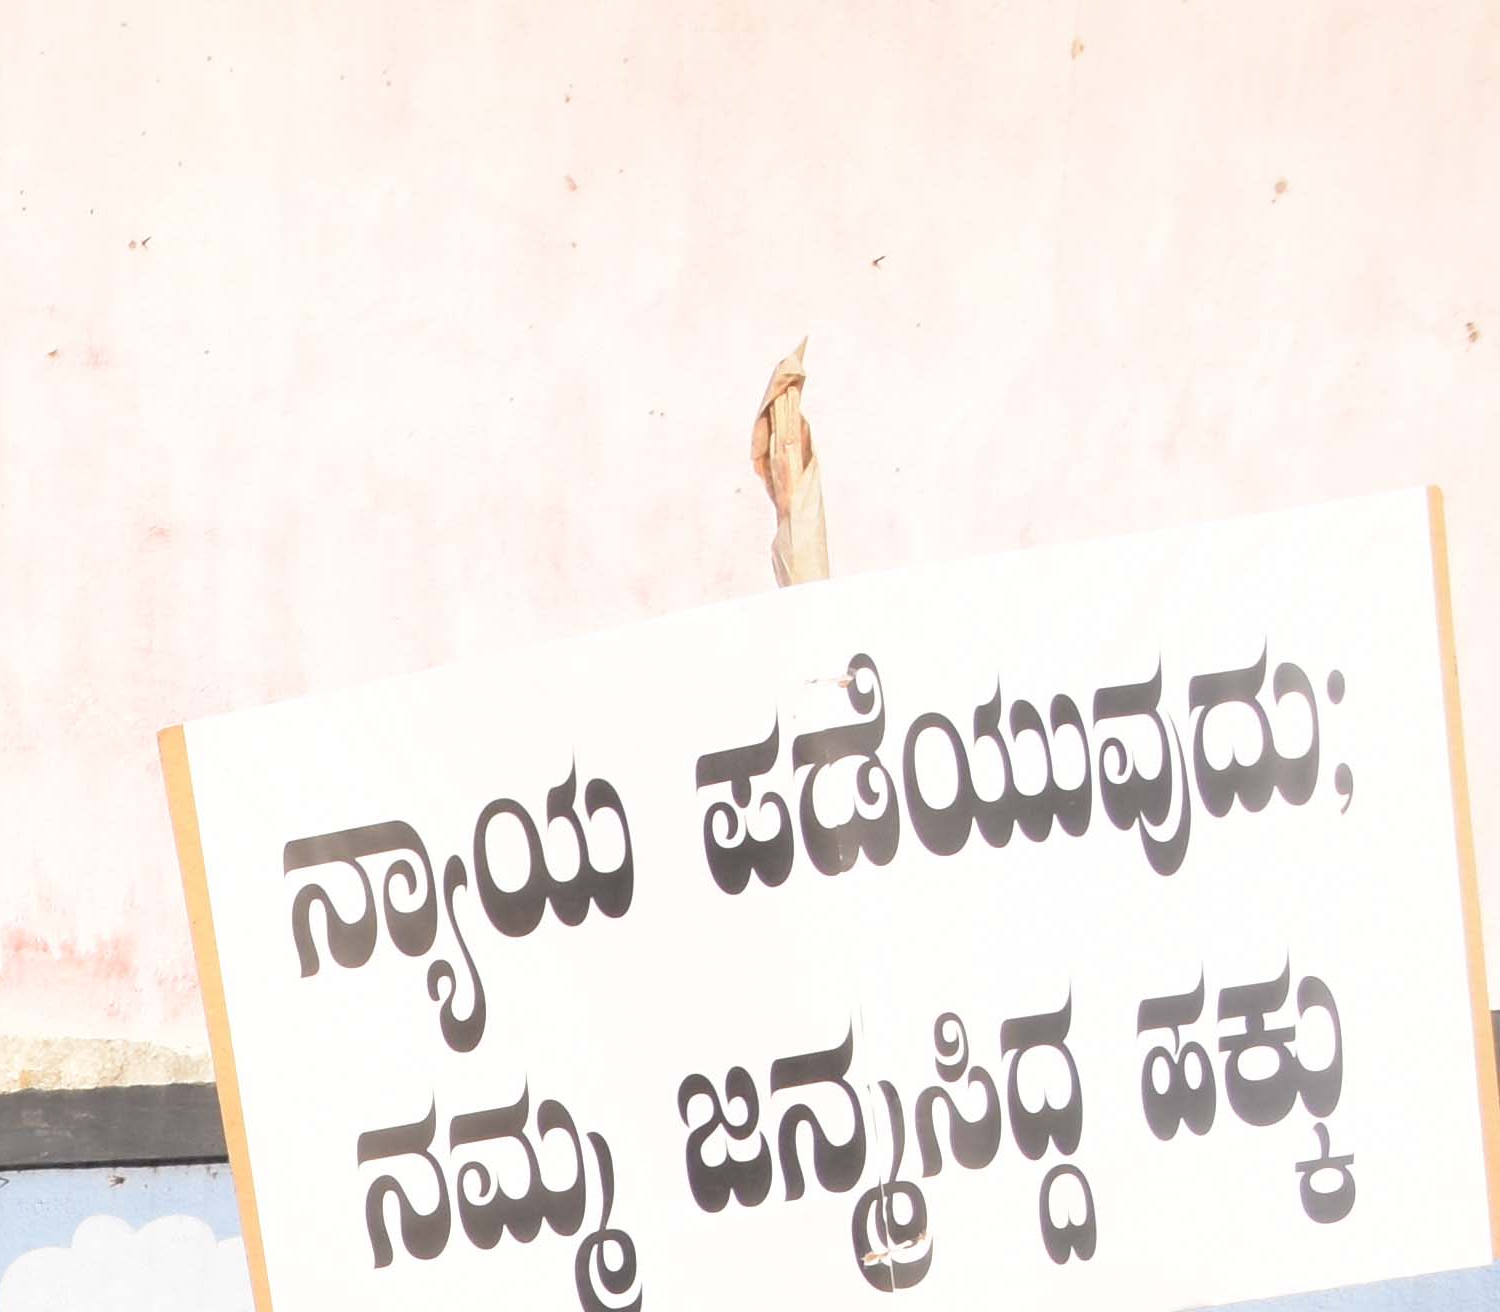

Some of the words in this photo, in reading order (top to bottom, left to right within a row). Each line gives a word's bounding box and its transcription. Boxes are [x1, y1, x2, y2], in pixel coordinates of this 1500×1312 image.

[284, 762, 634, 1052] ನ್ಯಾಯ
[696, 648, 1353, 895] ಪಡೆಯುವುದು;
[1138, 964, 1355, 1223] ಹಕ್ಕು
